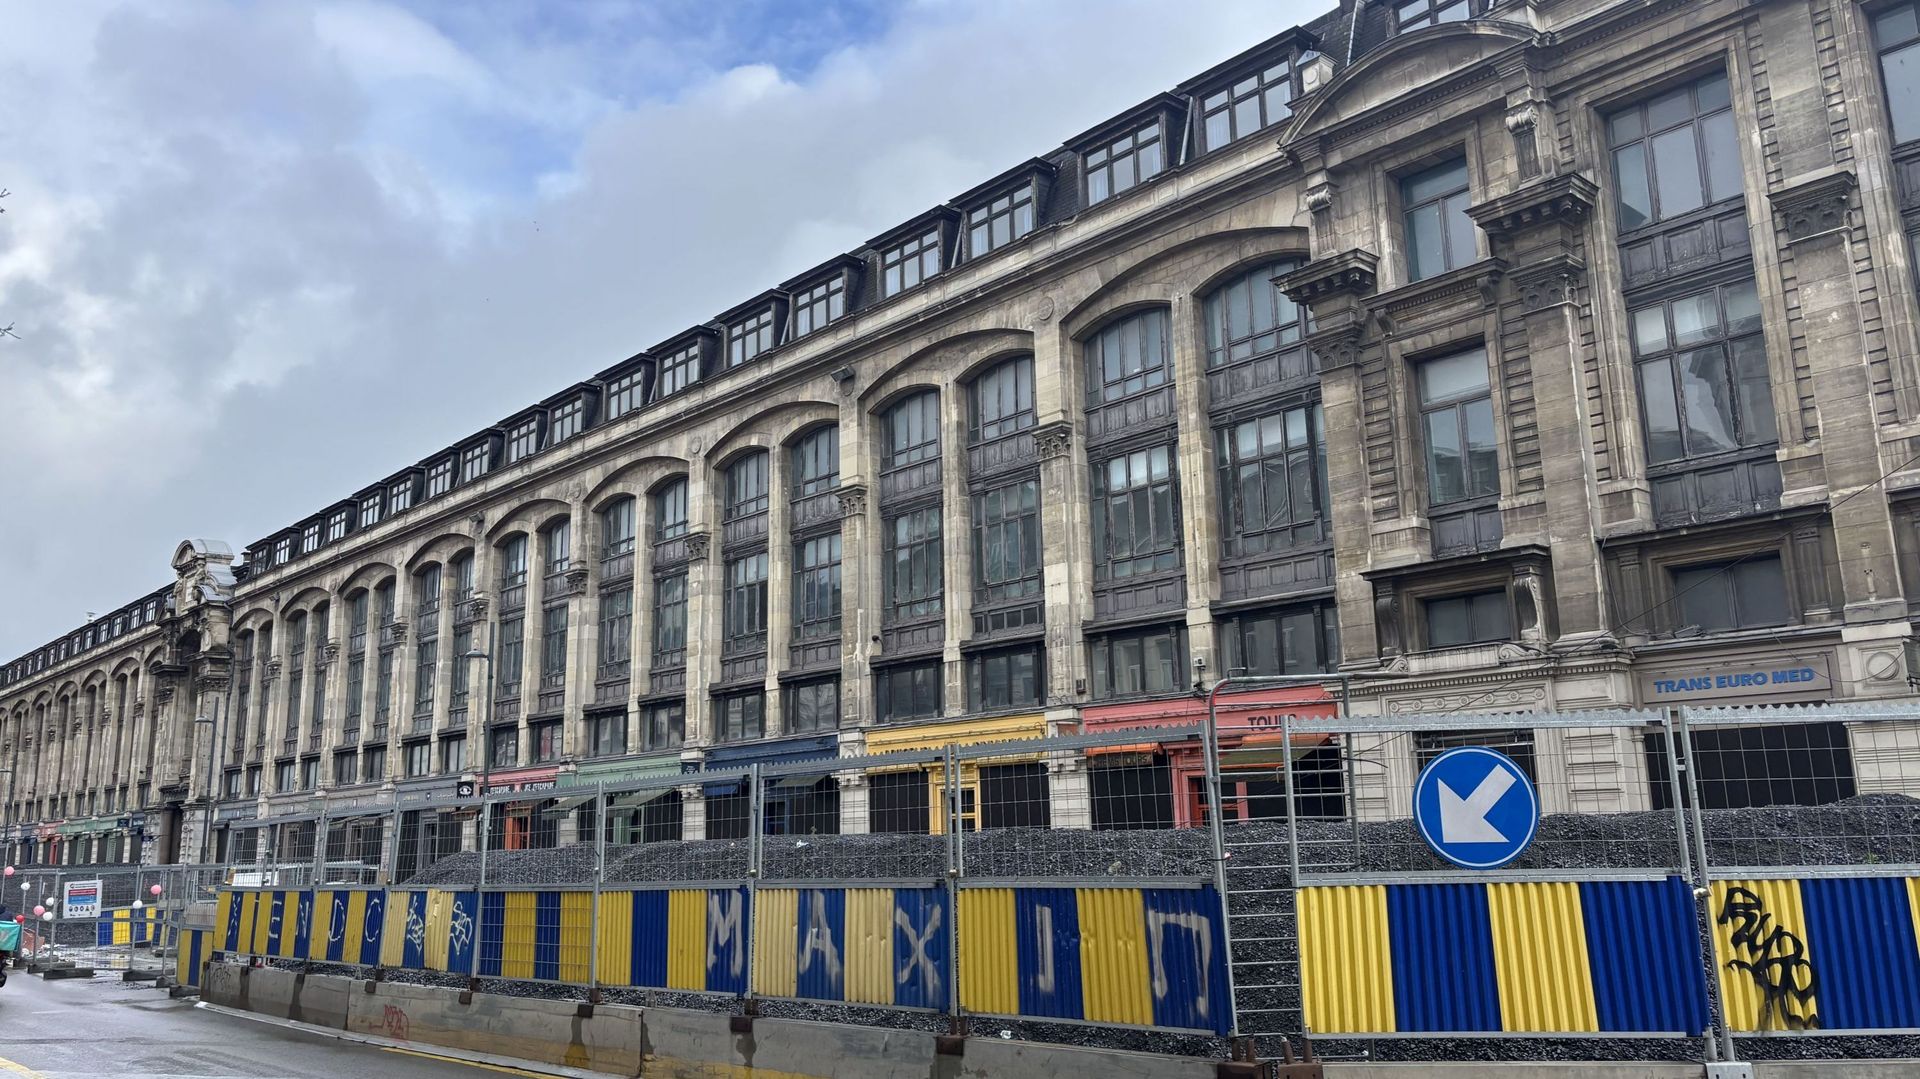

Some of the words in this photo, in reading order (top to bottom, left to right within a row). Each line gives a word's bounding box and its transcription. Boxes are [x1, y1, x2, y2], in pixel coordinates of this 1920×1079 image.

[1654, 676, 1712, 693] TRANS
[1716, 672, 1768, 688] EURO
[1772, 668, 1814, 684] MED
